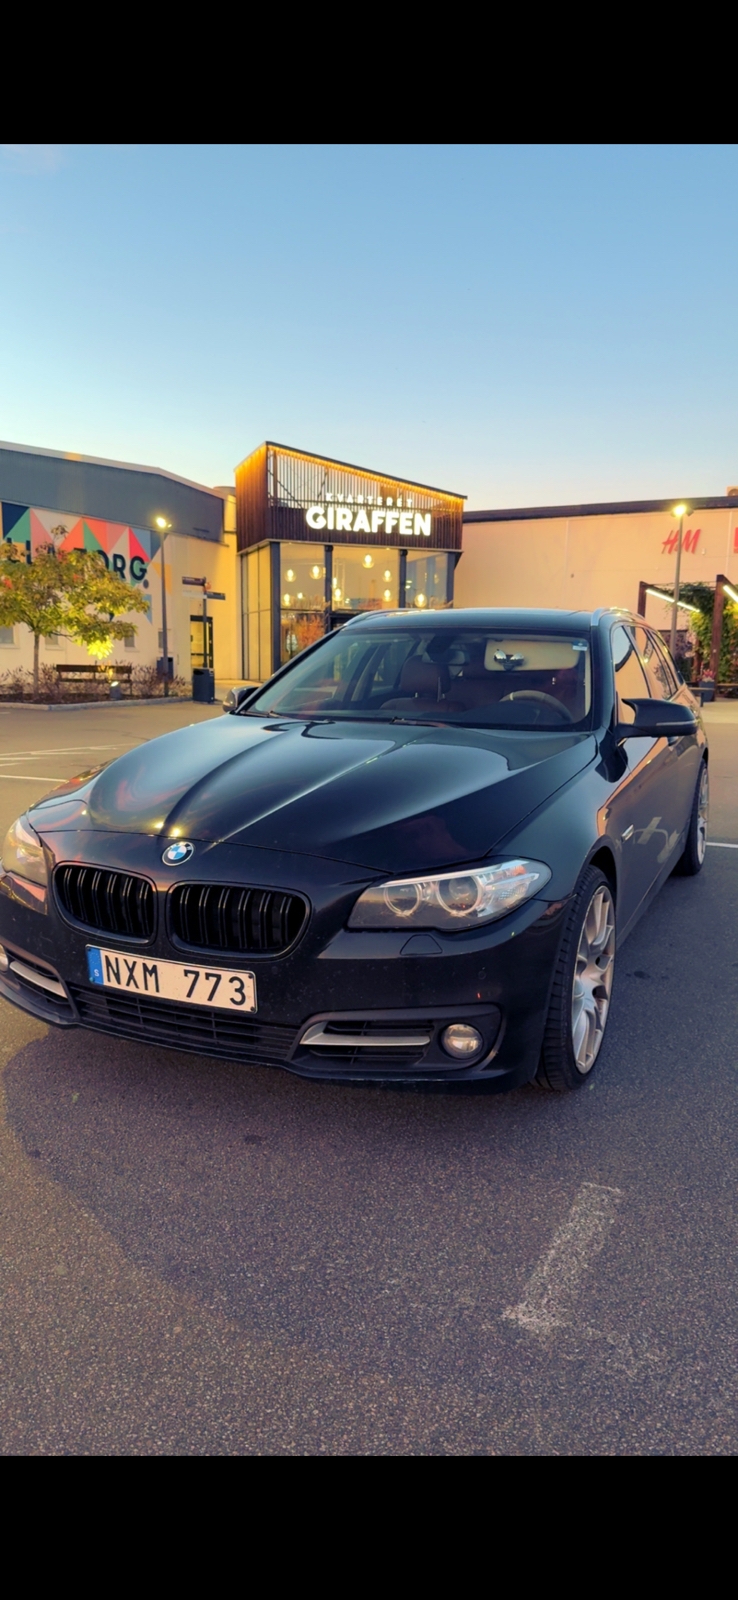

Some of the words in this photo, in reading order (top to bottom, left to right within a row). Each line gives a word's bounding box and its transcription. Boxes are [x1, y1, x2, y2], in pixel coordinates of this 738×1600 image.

[325, 492, 413, 508] KVARTERET
[305, 505, 431, 536] GIRAFFEN
[661, 528, 702, 555] HM
[93, 968, 100, 977] S
[104, 954, 160, 993] NXM
[183, 968, 247, 1006] 773
